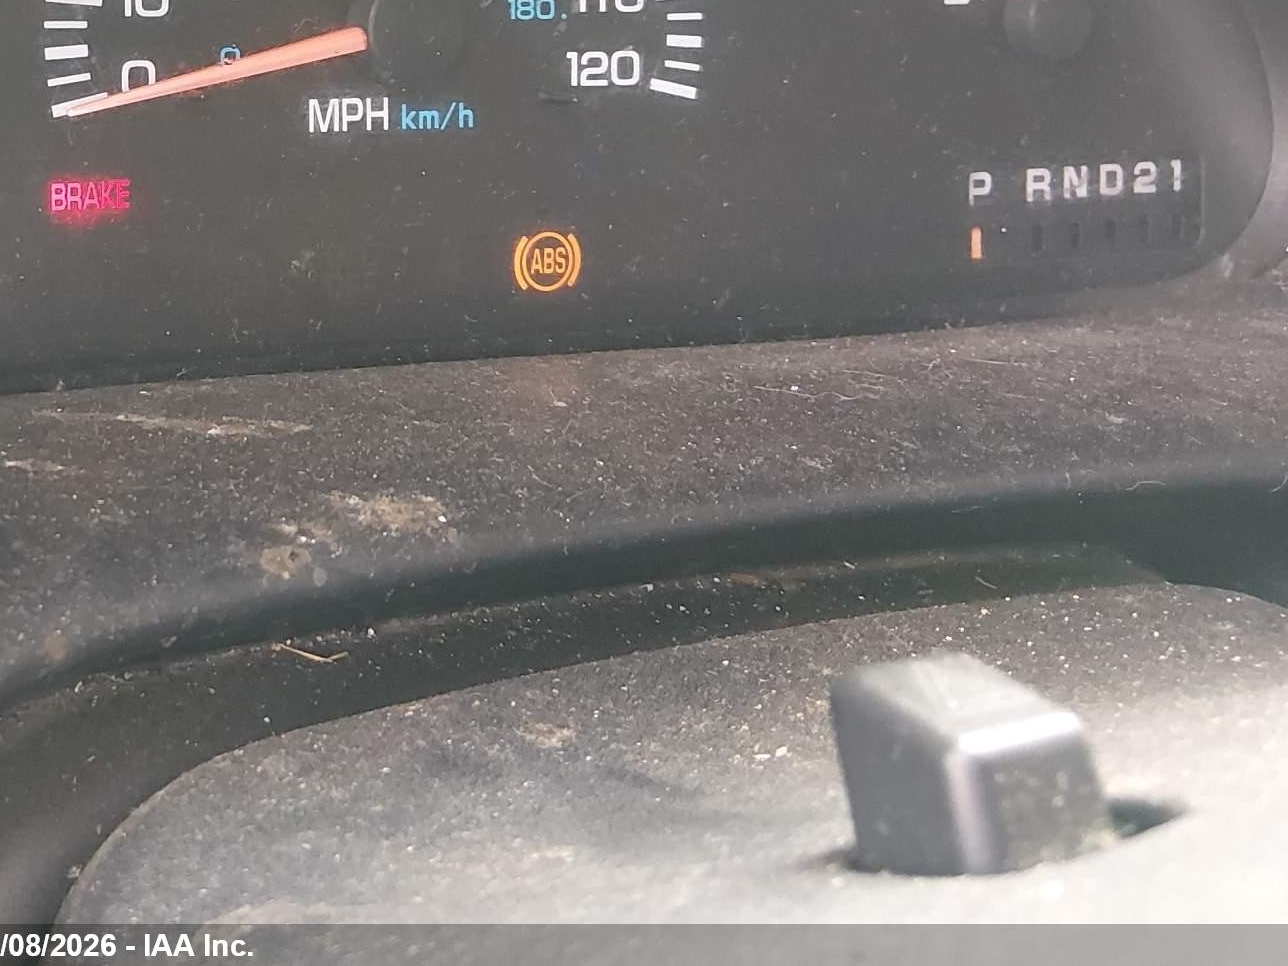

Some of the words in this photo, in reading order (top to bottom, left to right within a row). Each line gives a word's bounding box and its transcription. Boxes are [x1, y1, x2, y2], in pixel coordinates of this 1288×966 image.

[121, 60, 157, 93] 0
[566, 50, 641, 87] 120
[307, 96, 390, 133] MPH
[400, 100, 475, 130] km/h
[50, 179, 130, 211] BRAKE
[969, 171, 993, 206] P
[529, 246, 568, 275] ABS
